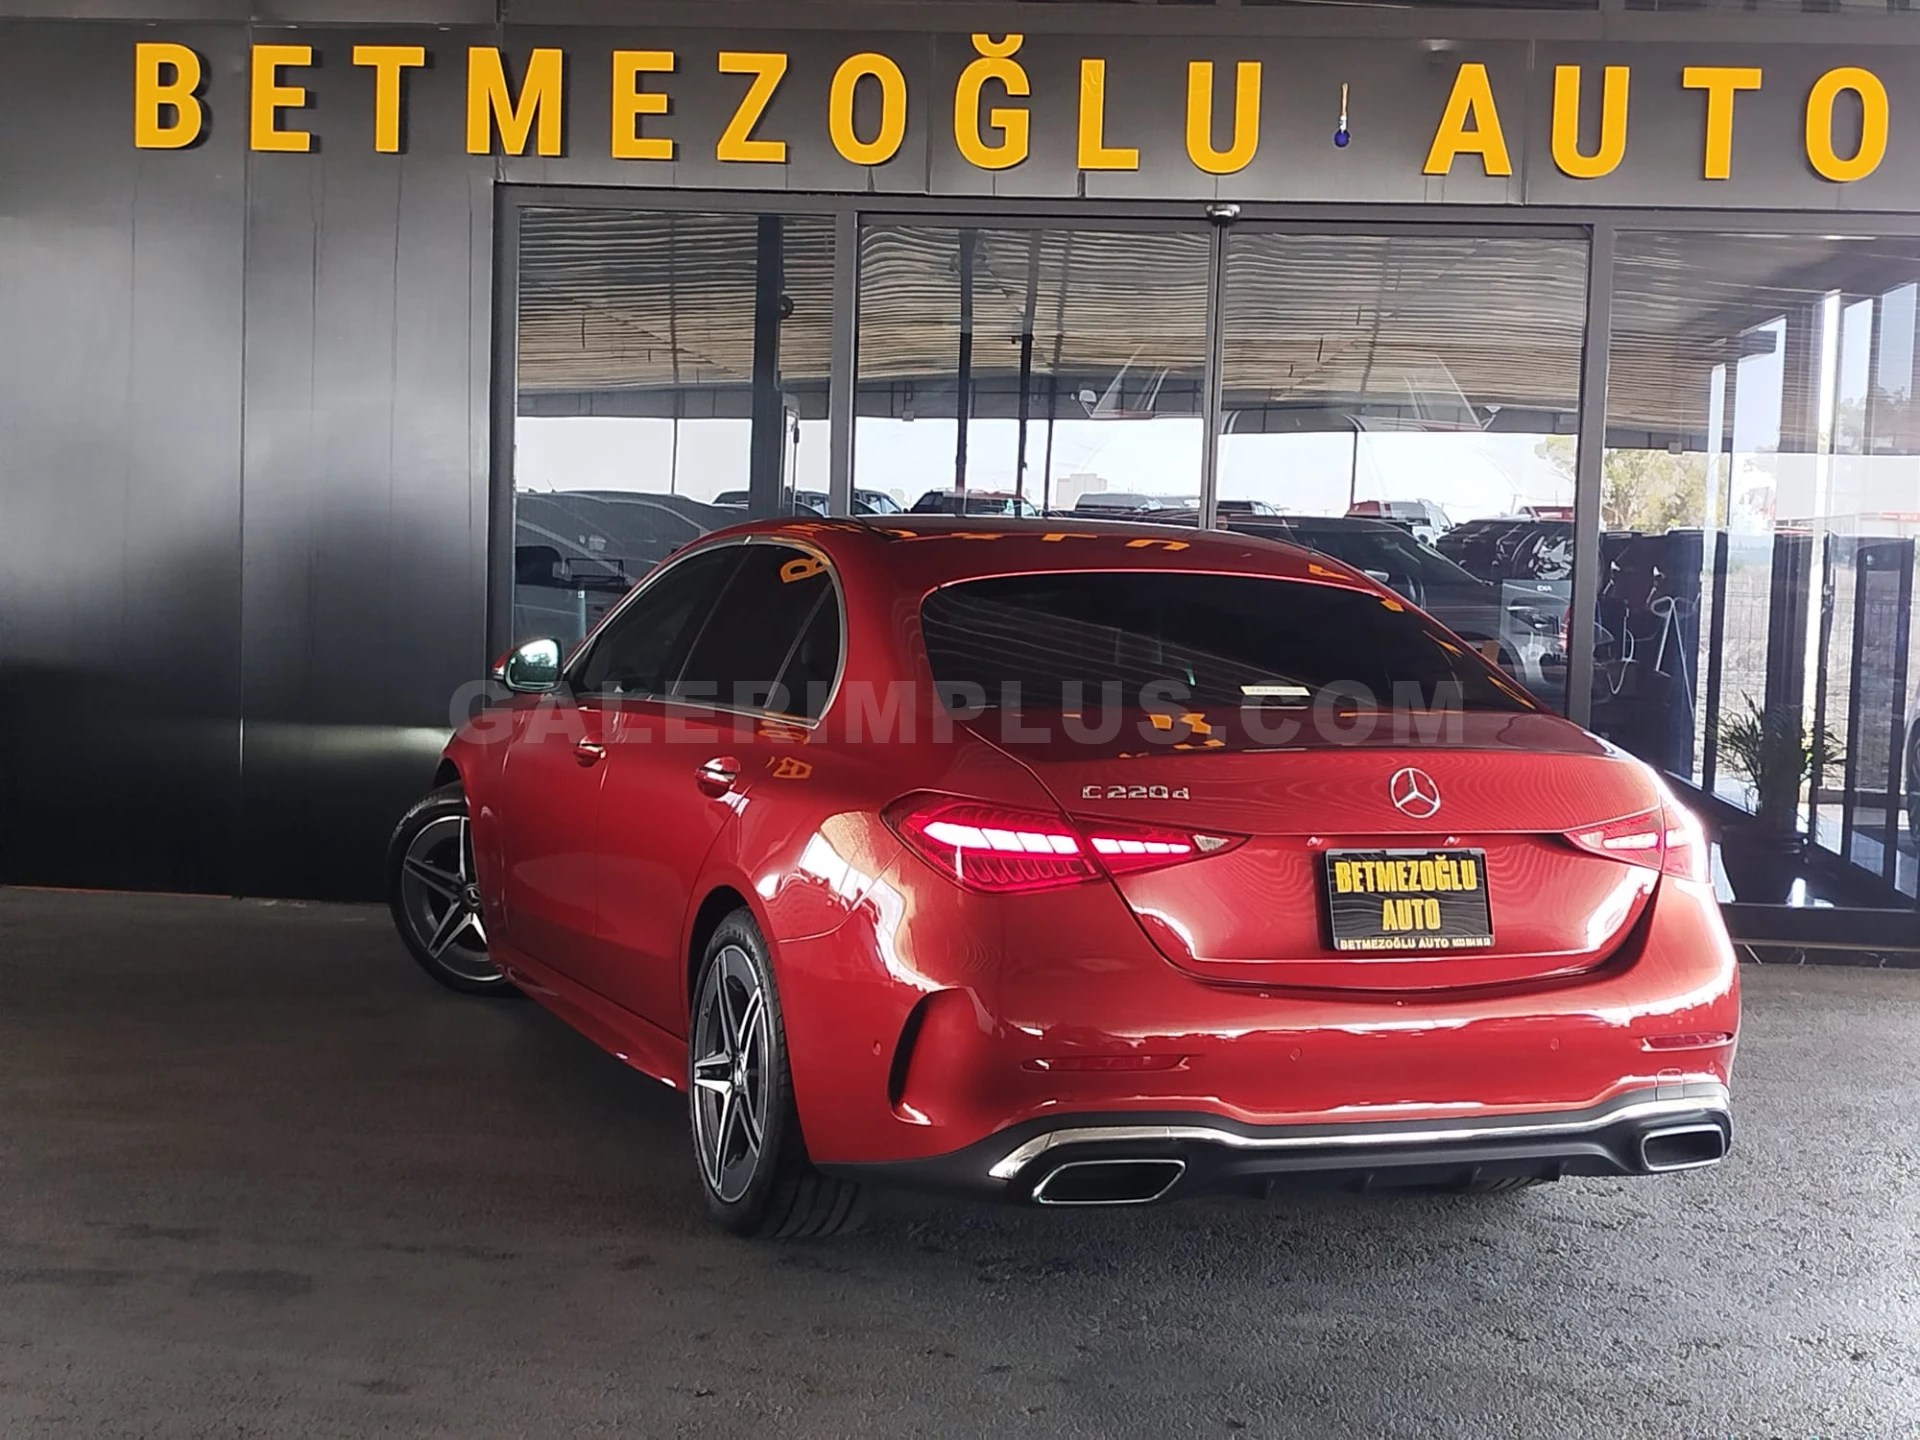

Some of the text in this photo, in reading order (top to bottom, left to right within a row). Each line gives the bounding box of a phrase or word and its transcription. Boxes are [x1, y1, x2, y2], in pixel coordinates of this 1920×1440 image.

[134, 33, 1888, 181] BETMEZOĞLU AUTO
[1334, 854, 1478, 893] BETMEZOĞLU
[1382, 898, 1441, 931] AUTO
[1418, 937, 1450, 949] AUTO
